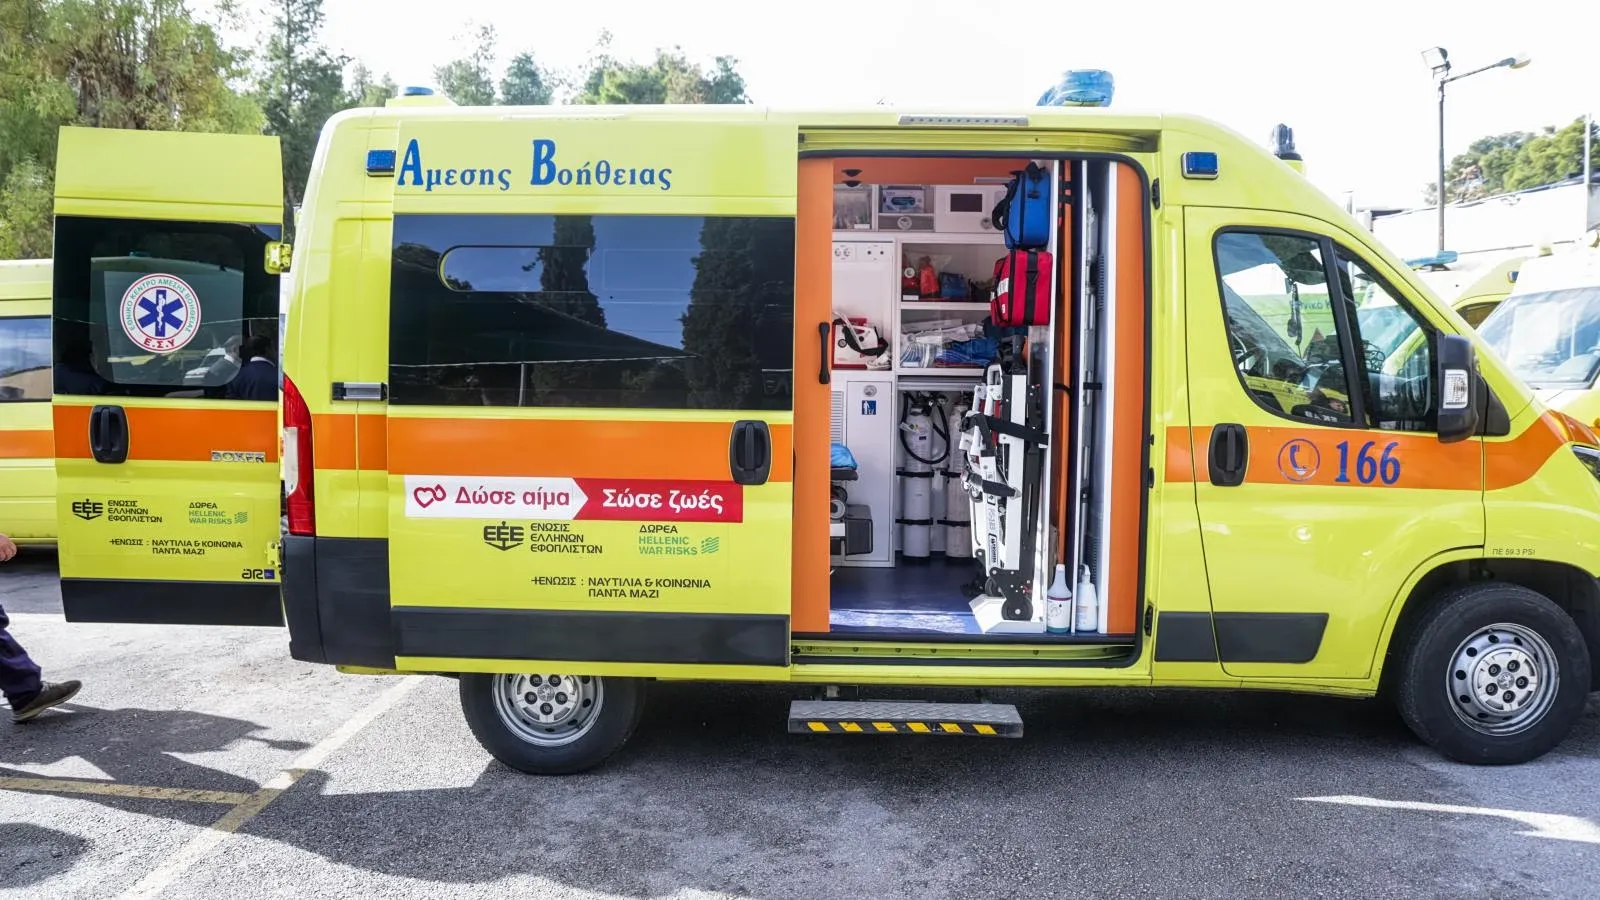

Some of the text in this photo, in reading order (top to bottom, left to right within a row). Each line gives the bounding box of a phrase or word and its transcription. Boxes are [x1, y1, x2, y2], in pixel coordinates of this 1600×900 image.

[397, 138, 673, 192] Αμεσης Βοήθειας
[1334, 440, 1401, 485] 166
[107, 499, 138, 507] ΕΝΩΣΙΣ
[455, 485, 724, 514] Δώσε αίμα Σώσε ζωές
[107, 507, 149, 515] ΕΛΛΗΝΩΝ
[107, 515, 163, 523] ΕΦΟΠΛΙΣΤΩΝ
[530, 522, 570, 532] ΕΝΩΣΙΣ
[639, 524, 678, 534] ΔΩΡΕΑ
[530, 533, 584, 543] ΕΛΛΗΝΩΝ
[638, 535, 690, 545] HELLENIC
[152, 539, 192, 547] ΝΑΥΤΙΛΙΑ
[201, 540, 243, 548] ΚΟΙΝΩΝΙΑ
[530, 543, 603, 554] ΕΦΟΠΛΙΣΤΩΝ
[152, 547, 205, 555] ΠΑΝΤΑ ΜΑΖΙ
[638, 546, 698, 556] WAR RISKS
[588, 577, 642, 587] ΝΑΥΤΙΛΙΑ
[645, 579, 654, 588] &
[655, 578, 711, 588] ΚΟΙΝΩΝΙΑ
[588, 588, 659, 599] ΠΑΝΤΑ ΜΑΖΙ
